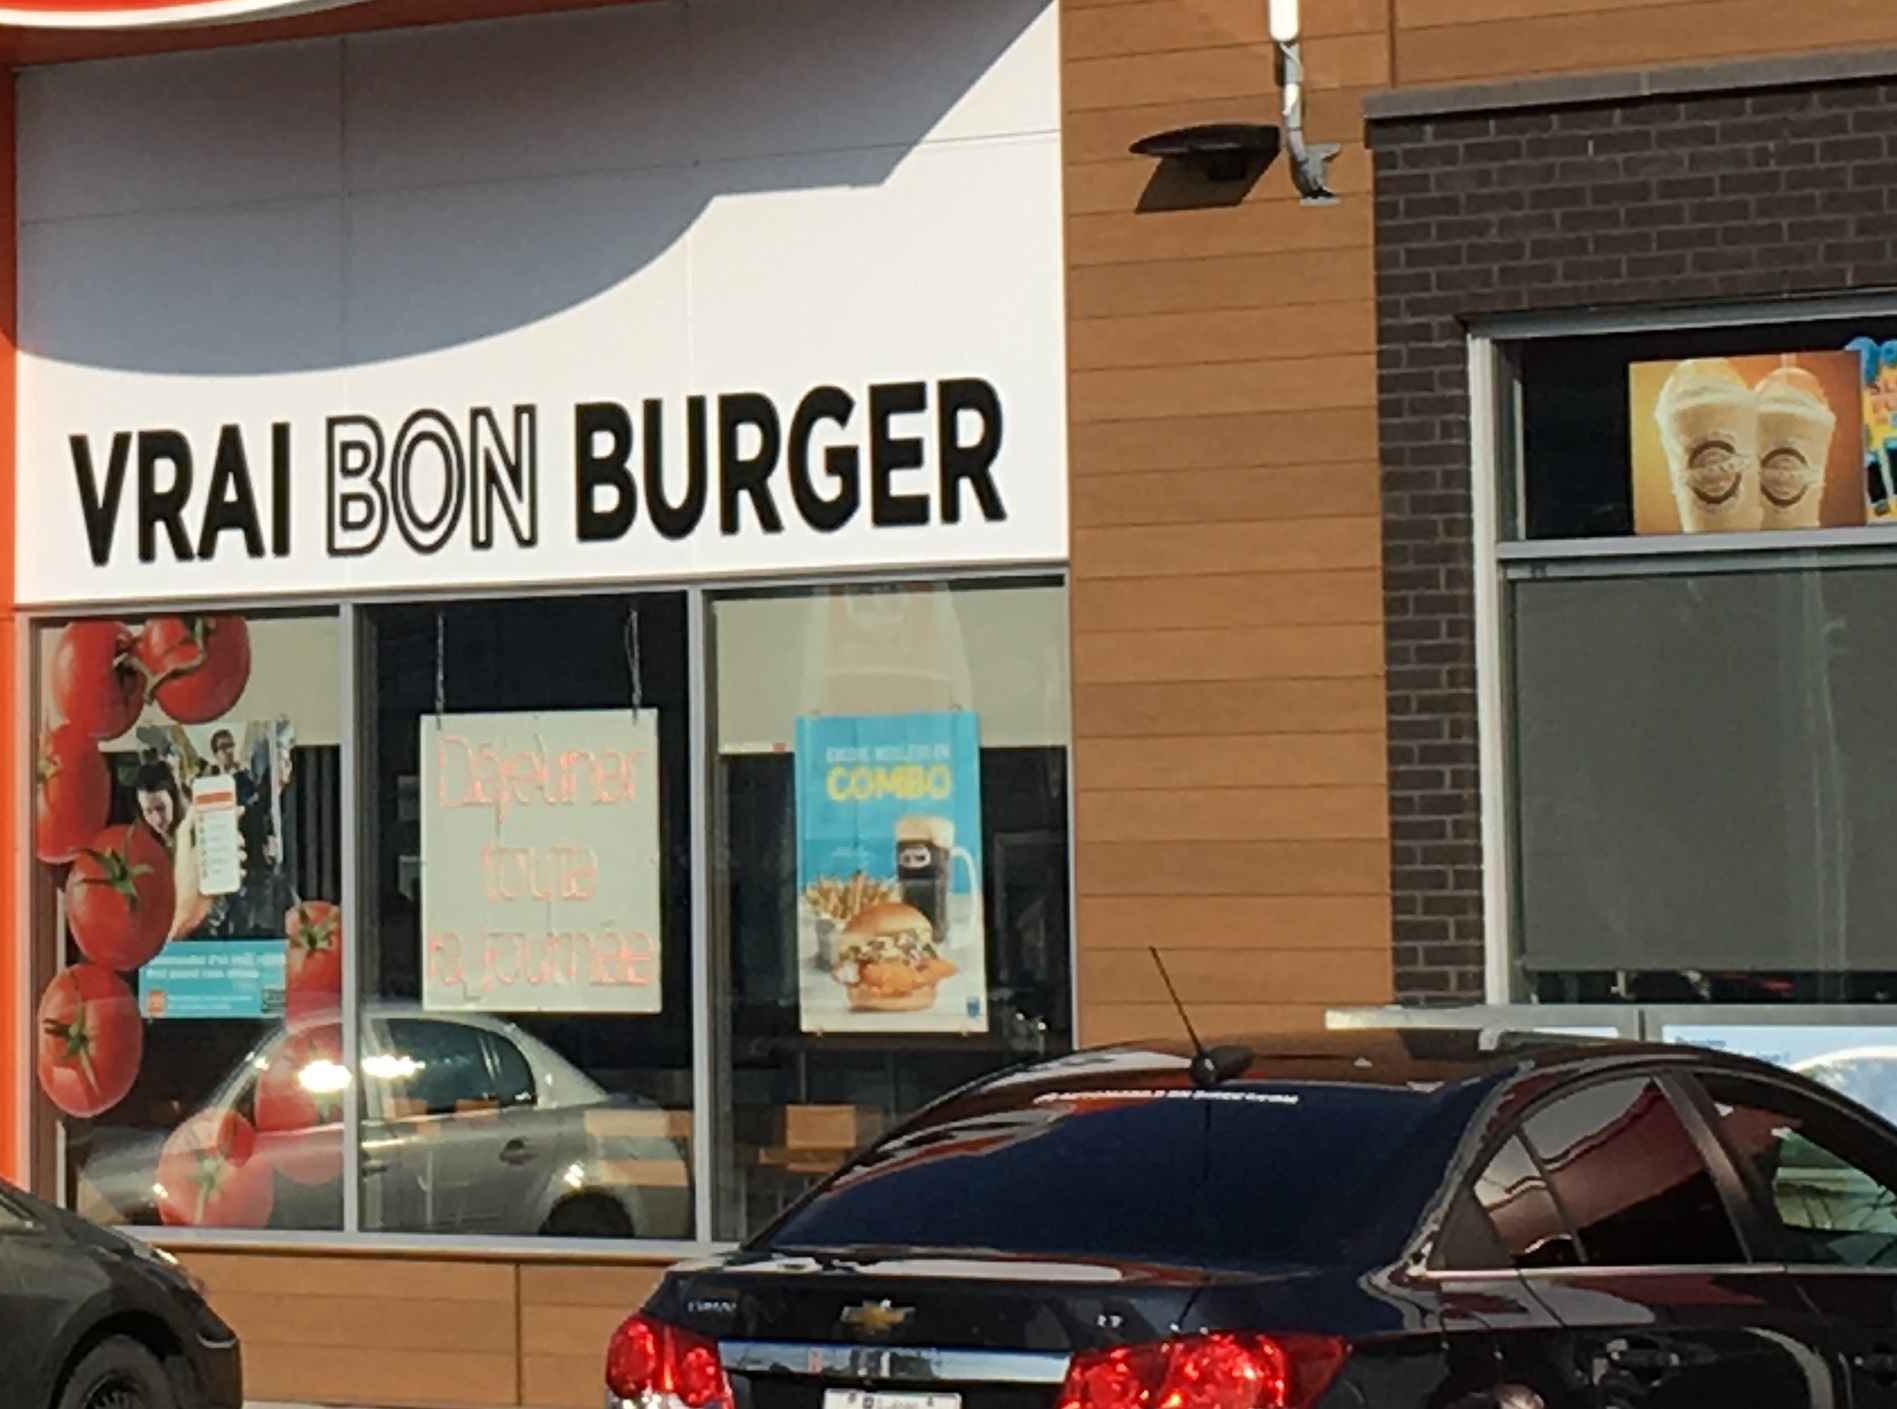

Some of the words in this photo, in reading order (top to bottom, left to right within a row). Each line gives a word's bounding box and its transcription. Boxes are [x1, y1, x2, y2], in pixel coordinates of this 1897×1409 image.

[68, 420, 291, 568] VRAI
[324, 402, 537, 558] BON
[573, 377, 1008, 544] BURGER
[825, 763, 952, 802] COMBO
